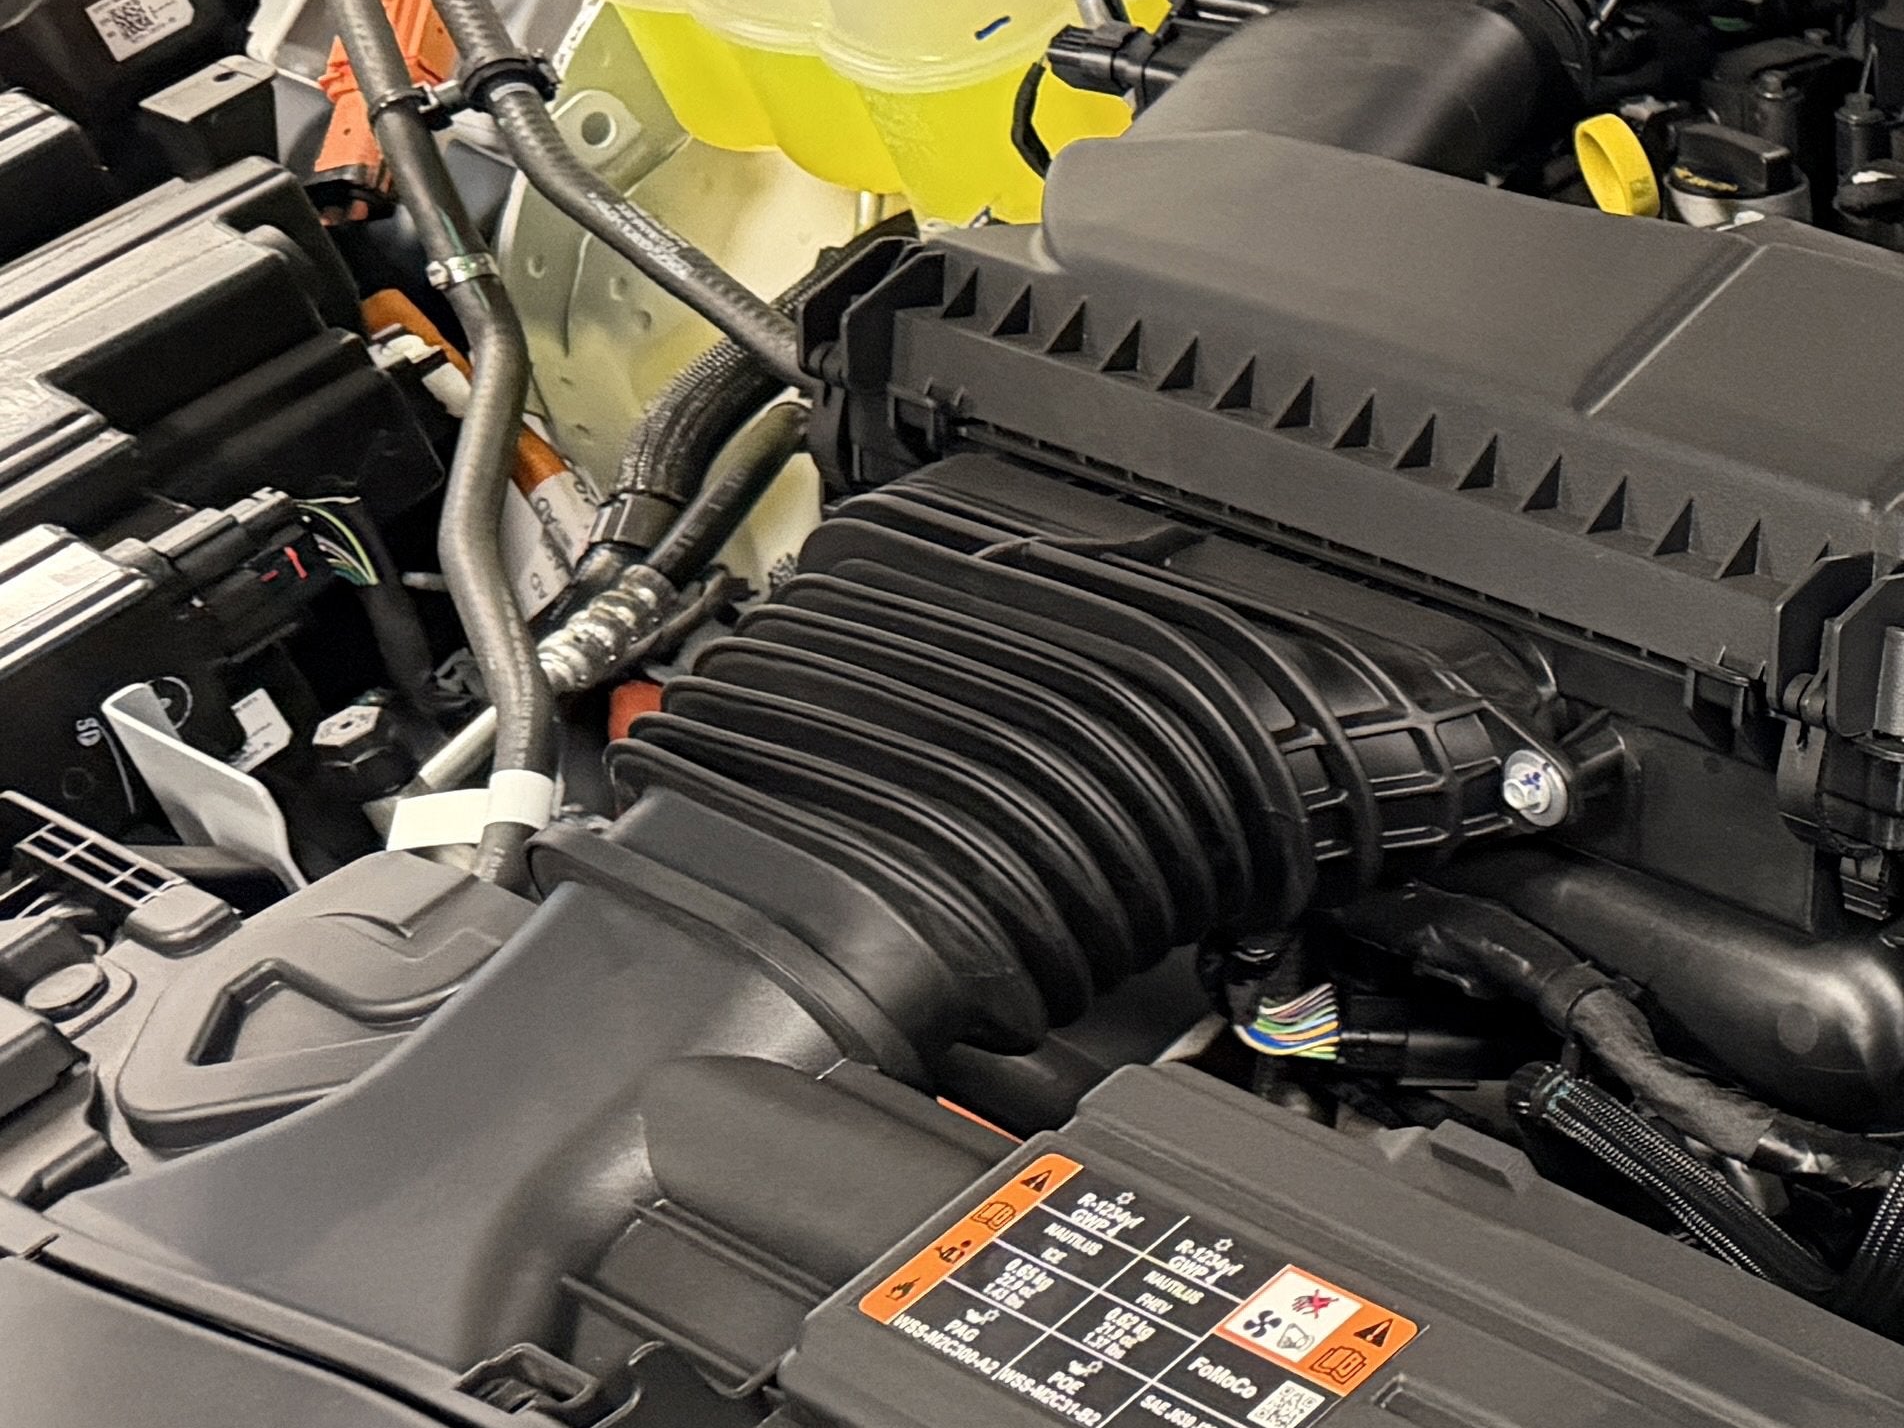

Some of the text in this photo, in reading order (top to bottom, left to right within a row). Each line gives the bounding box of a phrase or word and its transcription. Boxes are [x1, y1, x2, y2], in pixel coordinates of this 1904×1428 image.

[1070, 1208, 1110, 1230] GWP
[1043, 1222, 1103, 1256] NAUTILUS
[1168, 1255, 1209, 1276] GWP
[1143, 1270, 1204, 1304] NAUTILUS
[1134, 1292, 1173, 1314] FHEV
[943, 1318, 979, 1342] PAG
[1046, 1370, 1085, 1395] POE
[1187, 1356, 1257, 1398] FoMoCo
[1139, 1394, 1171, 1416] SAE
